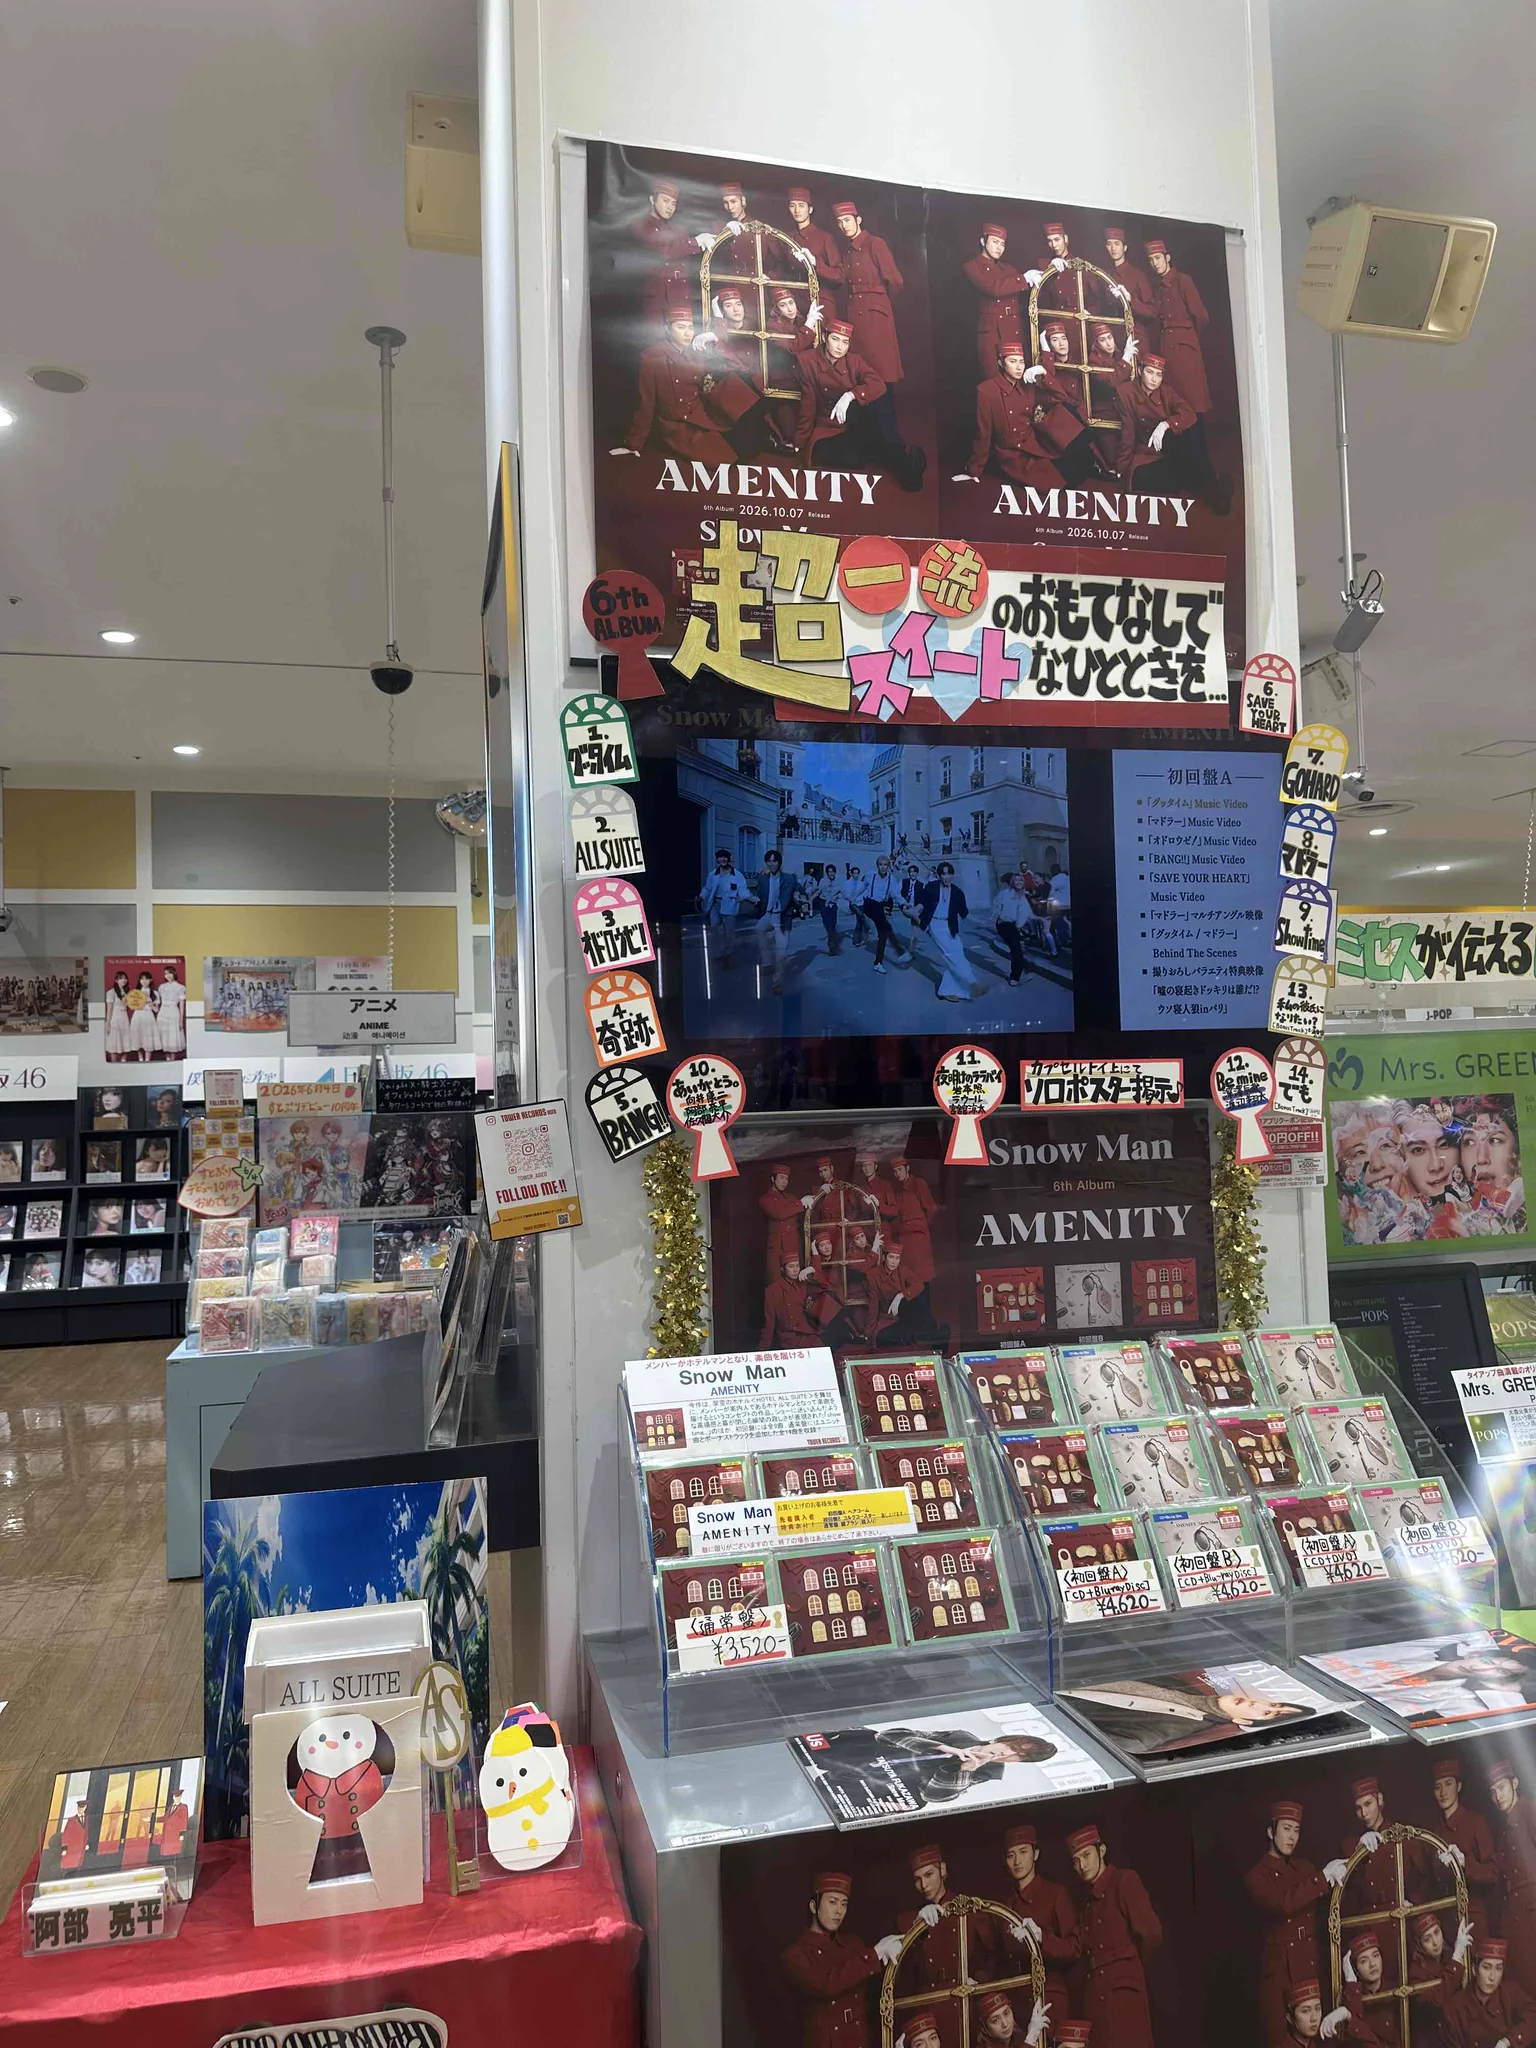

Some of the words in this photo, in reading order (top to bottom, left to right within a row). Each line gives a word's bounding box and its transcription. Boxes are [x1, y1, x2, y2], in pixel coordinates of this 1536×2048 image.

[656, 459, 882, 504] AMENITY
[715, 505, 735, 513] Album
[739, 505, 804, 519] 2026.10.07
[808, 511, 831, 519] Release
[993, 484, 1195, 527] AMENITY
[1046, 527, 1064, 535] Album
[1067, 526, 1125, 541] 2026.10.07
[589, 580, 649, 616] 6th
[593, 612, 663, 641] ALBUM
[1262, 681, 1278, 697] 6.
[1247, 693, 1275, 709] SAVE
[657, 705, 731, 726] Snow
[1250, 708, 1281, 722] YOUR
[587, 725, 610, 742] 1.
[1251, 717, 1287, 733] HEART
[1307, 748, 1325, 766] 7.
[1167, 767, 1233, 786] 初回盤A
[1194, 799, 1221, 809] Music
[1223, 800, 1248, 809] Video
[594, 816, 616, 833] 2.
[1188, 817, 1214, 828] Music
[1216, 818, 1242, 828] Video
[1203, 836, 1230, 846] Music
[1232, 836, 1257, 846] Video
[1301, 830, 1319, 850] 8.
[1191, 855, 1218, 865] Music
[1220, 855, 1245, 865] Video
[1281, 842, 1329, 878] マドラー
[1182, 873, 1210, 883] YOUR
[1150, 892, 1178, 902] Music
[1180, 892, 1205, 902] Video
[601, 909, 616, 927] 3
[1298, 901, 1314, 922] 9.
[1153, 948, 1185, 959] Behind
[1186, 949, 1204, 958] The
[1206, 949, 1238, 958] Scenes
[1287, 981, 1313, 1000] 13.
[350, 998, 398, 1014] アニメ
[612, 1003, 634, 1020] 4.
[1276, 997, 1325, 1014] 私の彼氏に
[1425, 1008, 1453, 1021] J-POP
[359, 1022, 390, 1030] ANIME
[596, 1011, 656, 1057] 奇跡
[955, 1050, 981, 1065] 11.
[1226, 1055, 1250, 1072] 12.
[688, 1060, 716, 1077] 10.
[935, 1066, 1004, 1086] 夜明けのララバイ
[1030, 1060, 1143, 1075] カプセルトイ上にて
[1288, 1065, 1314, 1085] 14.
[1381, 1057, 1445, 1082] Mrs.
[1216, 1071, 1235, 1091] Be
[1236, 1071, 1268, 1085] mine
[260, 1085, 341, 1098] 2026年6月4日
[952, 1095, 983, 1104] ラウール
[1278, 1081, 1313, 1104] でも
[613, 1092, 639, 1112] 5.
[599, 1100, 670, 1157] BANG!!
[988, 1138, 1088, 1166] Snow
[1096, 1133, 1174, 1162] Man
[243, 1166, 259, 1181] 6/4
[495, 1184, 539, 1204] FOLLOW
[541, 1180, 559, 1196] ME
[1053, 1180, 1073, 1192] 6th
[1076, 1179, 1116, 1191] Album
[975, 1204, 1193, 1247] AMENITY
[1360, 1308, 1390, 1323] POPS
[679, 1370, 733, 1385] Snow
[746, 1364, 787, 1380] Man
[710, 1383, 760, 1397] AMENITY
[1461, 1382, 1495, 1398] Mrs.
[1475, 1428, 1509, 1442] POPS
[697, 1509, 741, 1524] Snow
[744, 1506, 773, 1519] Man
[702, 1523, 772, 1541] AMENITY
[279, 1680, 326, 1707] ALL
[332, 1671, 401, 1701] SUITE
[806, 1733, 823, 1747] Us
[35, 1908, 89, 1949] 阿部
[109, 1899, 163, 1940] 亮平
